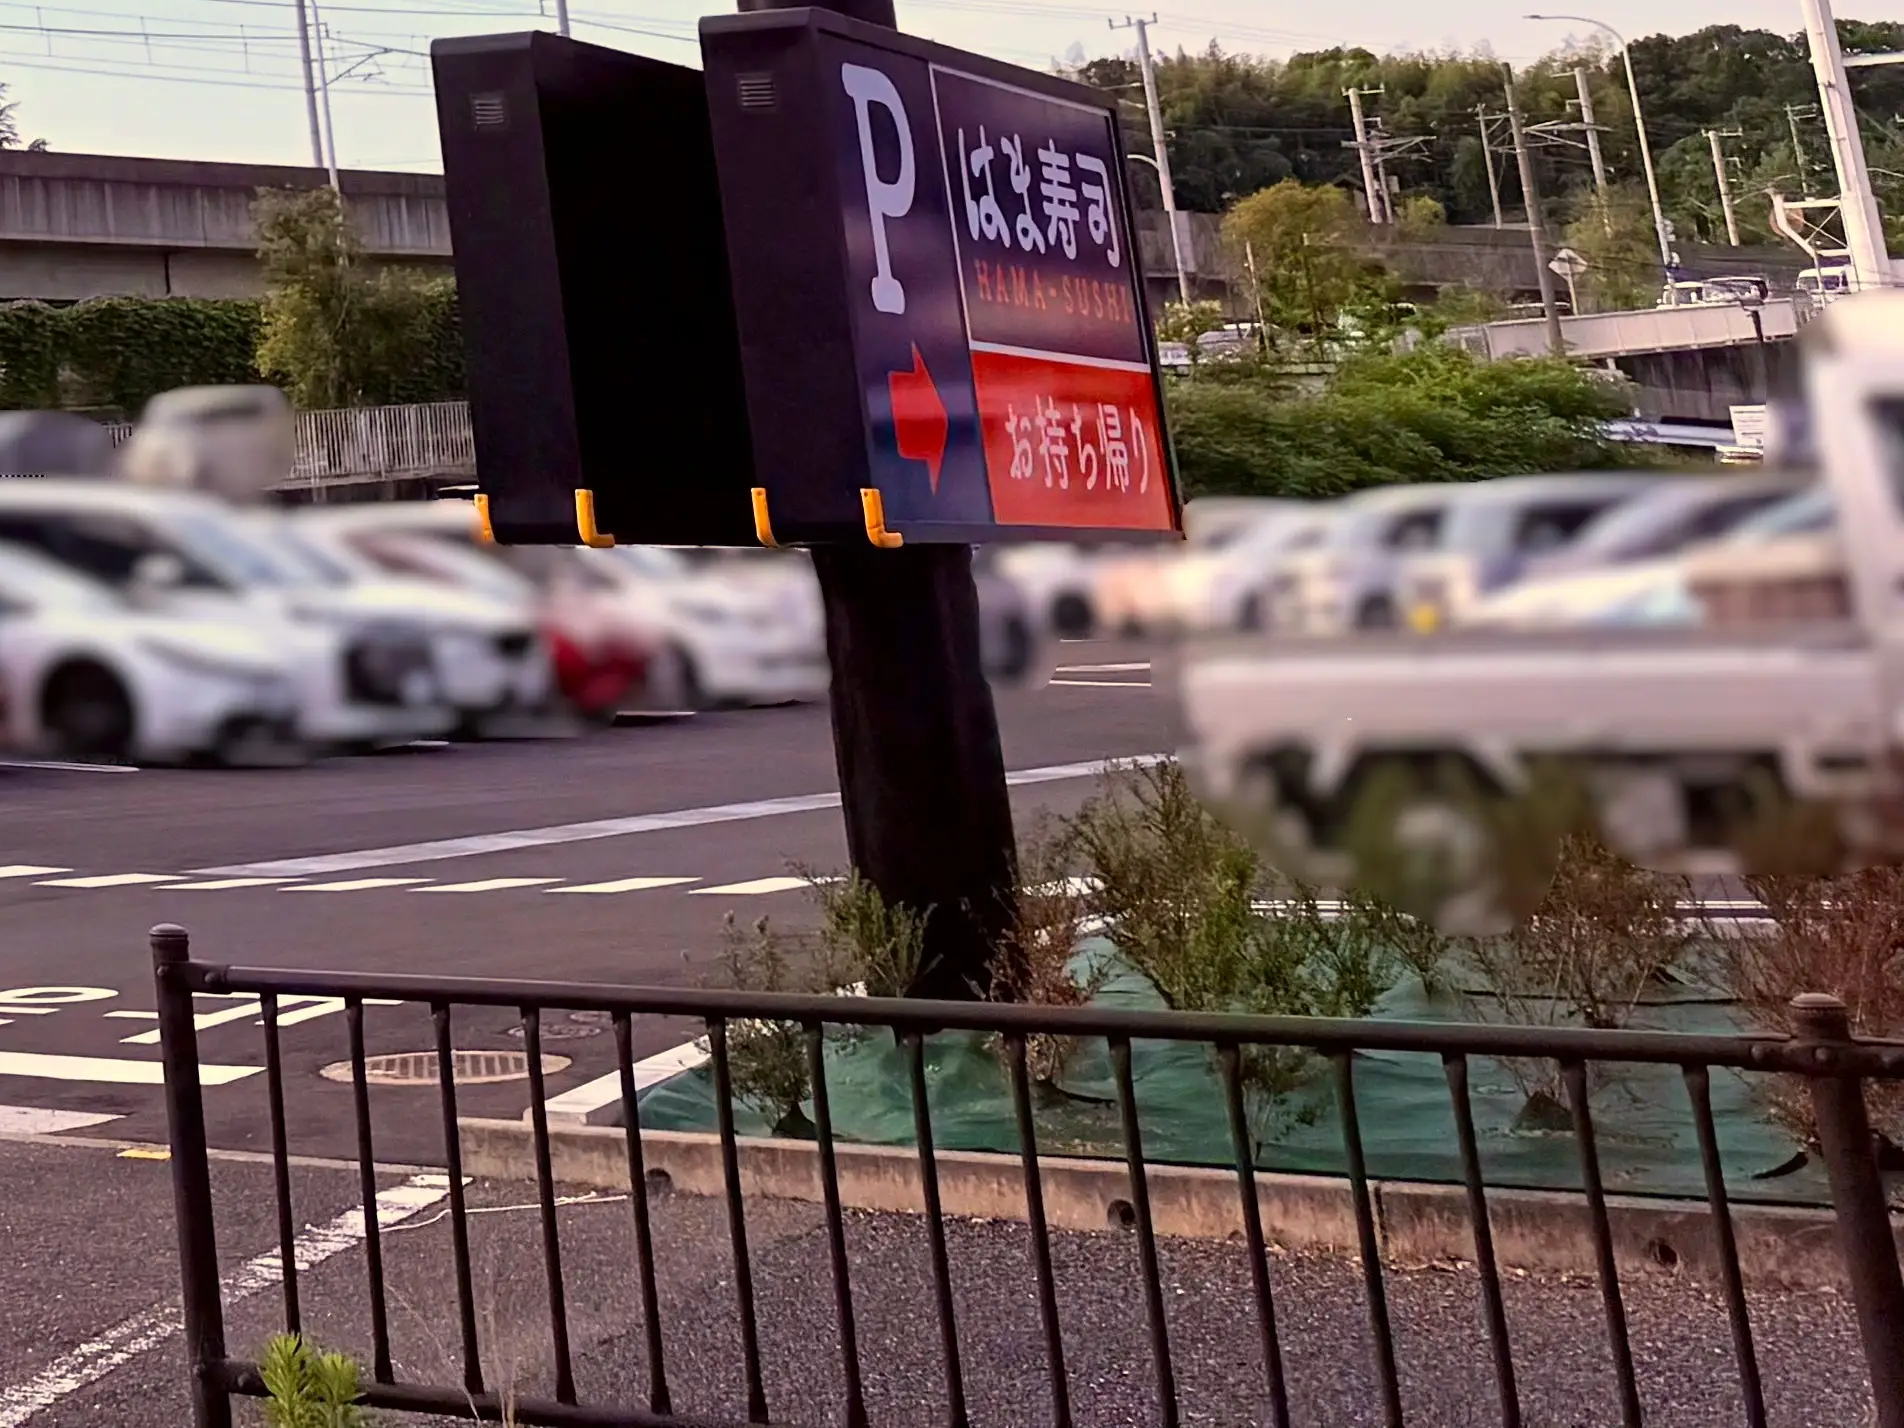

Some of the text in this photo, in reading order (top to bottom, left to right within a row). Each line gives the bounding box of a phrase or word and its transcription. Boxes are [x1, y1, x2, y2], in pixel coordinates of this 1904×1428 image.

[842, 61, 916, 315] P
[958, 123, 1121, 269] はま寿司
[977, 258, 1132, 324] HAMA-SUSHI
[1005, 394, 1150, 496] お持ち帰り
